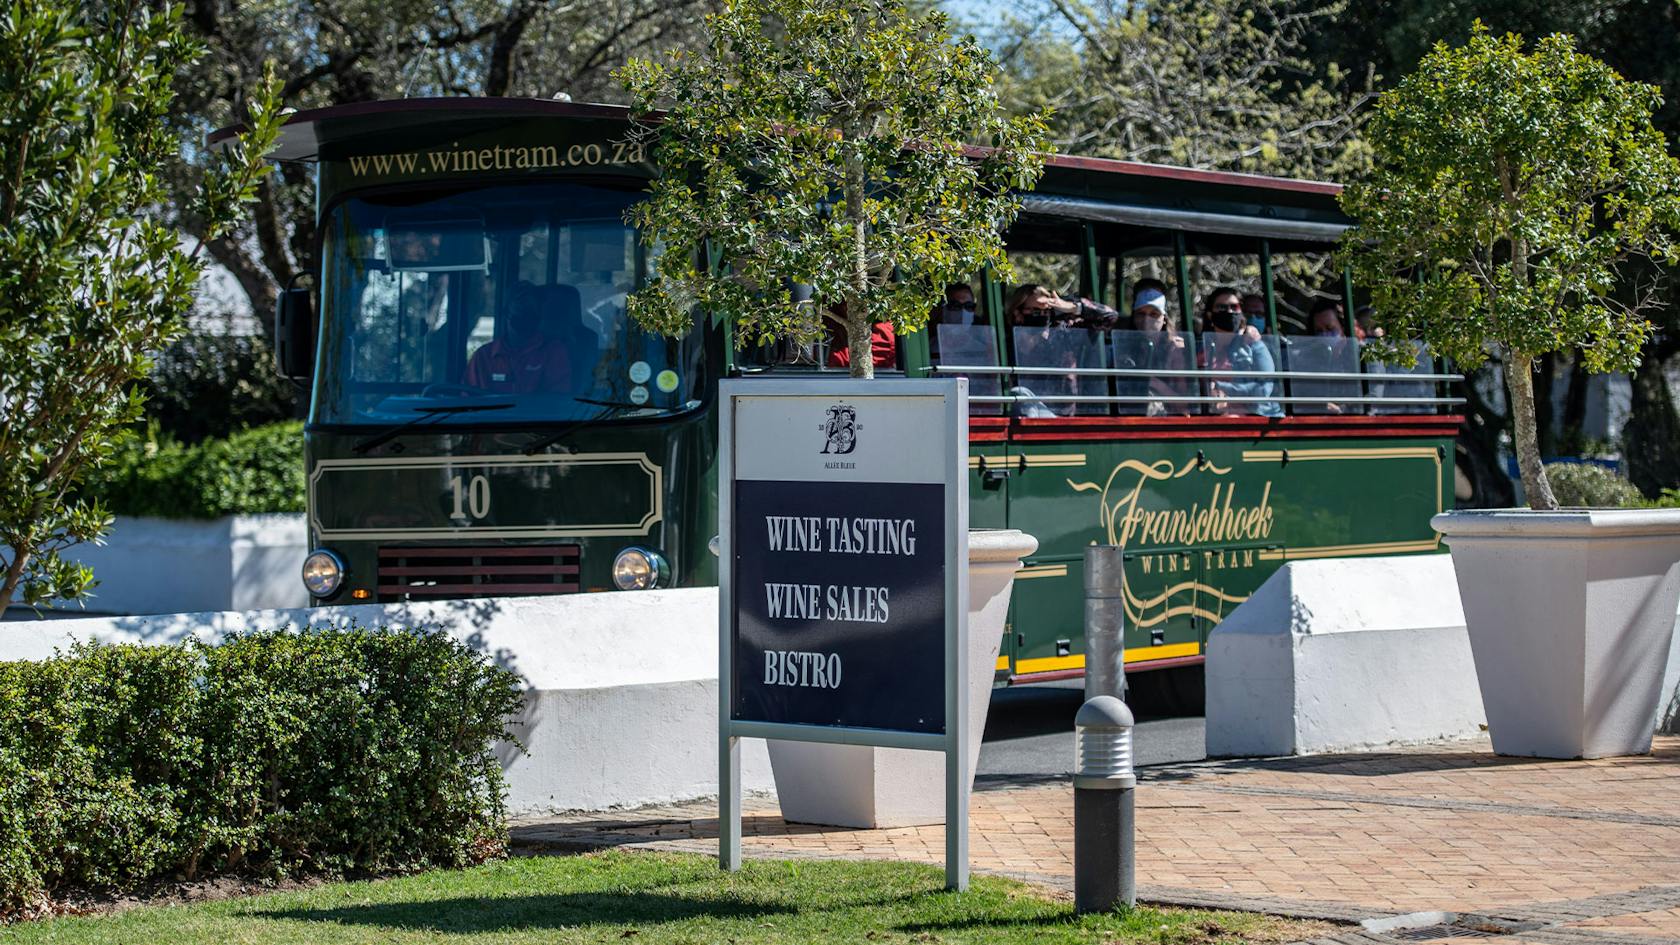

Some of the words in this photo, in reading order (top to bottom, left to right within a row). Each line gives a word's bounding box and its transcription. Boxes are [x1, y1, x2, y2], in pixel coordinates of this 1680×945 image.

[349, 142, 646, 176] www.winetram.co.za
[449, 475, 491, 519] 10
[1101, 459, 1274, 549] Franschhoek
[766, 516, 821, 552] WINE
[827, 517, 916, 555] TASTING
[1141, 555, 1191, 573] WINE
[1204, 551, 1253, 569] TRAM
[765, 583, 821, 619] WINE
[827, 585, 889, 623] SALES
[764, 650, 842, 688] BISTRO
